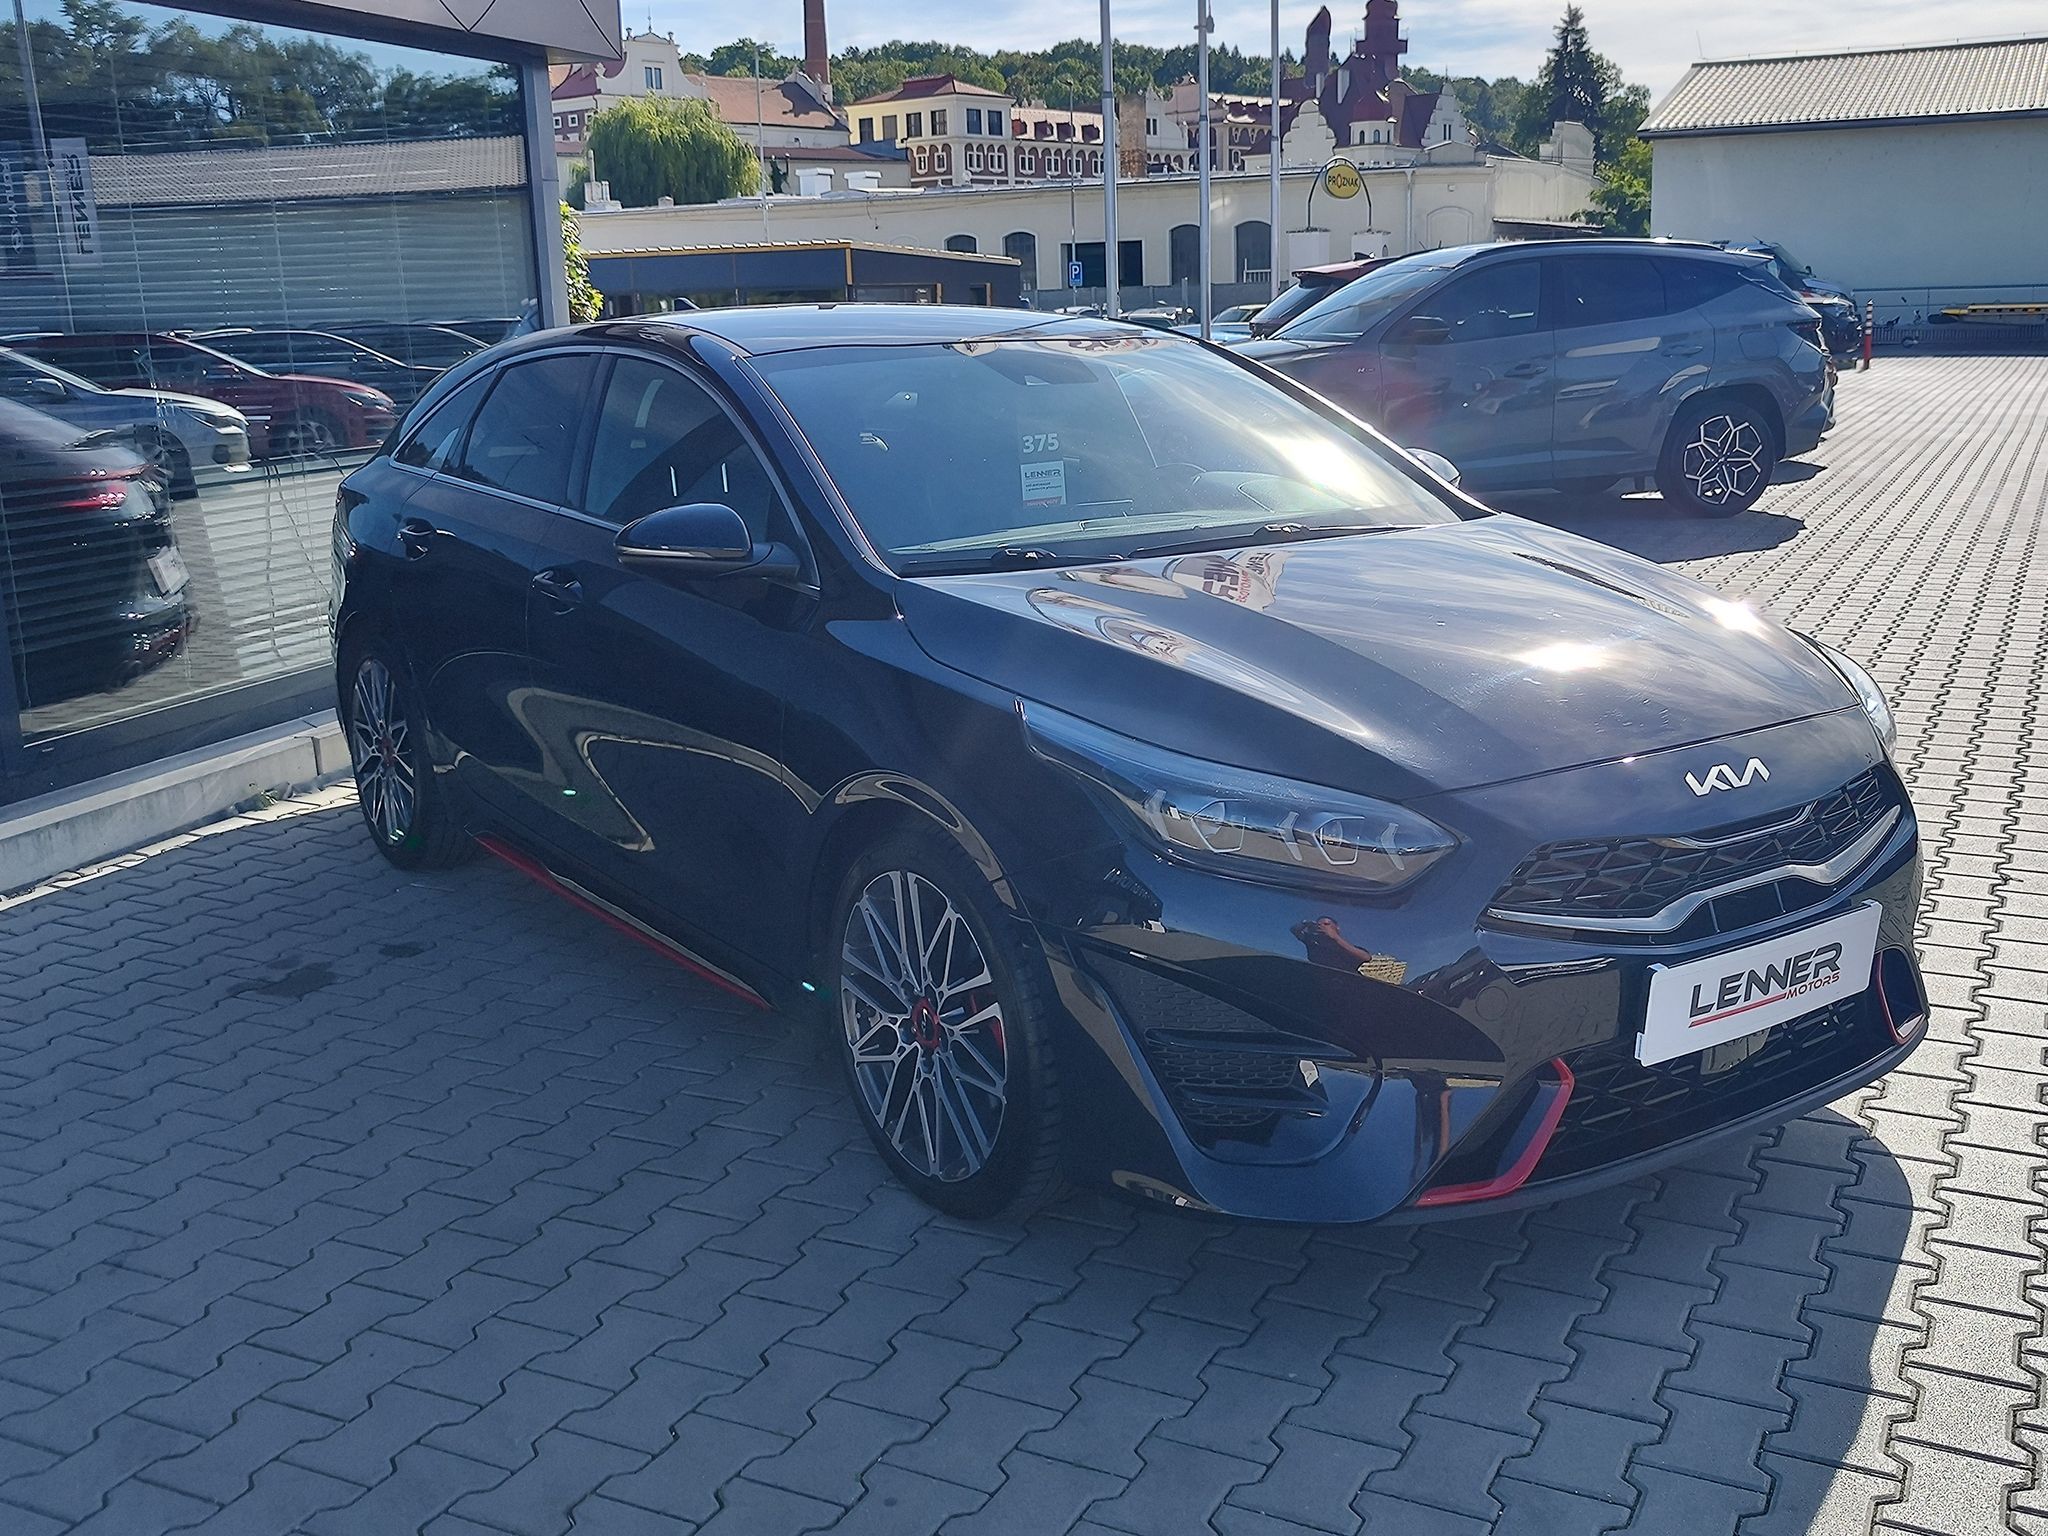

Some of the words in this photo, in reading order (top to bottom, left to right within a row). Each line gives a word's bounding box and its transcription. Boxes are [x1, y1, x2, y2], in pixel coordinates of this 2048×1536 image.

[1071, 265, 1080, 279] P
[1022, 433, 1060, 453] 375
[1684, 757, 1770, 796] KIA
[1689, 942, 1842, 1018] LENNER
[1787, 971, 1840, 1000] MOTORS
